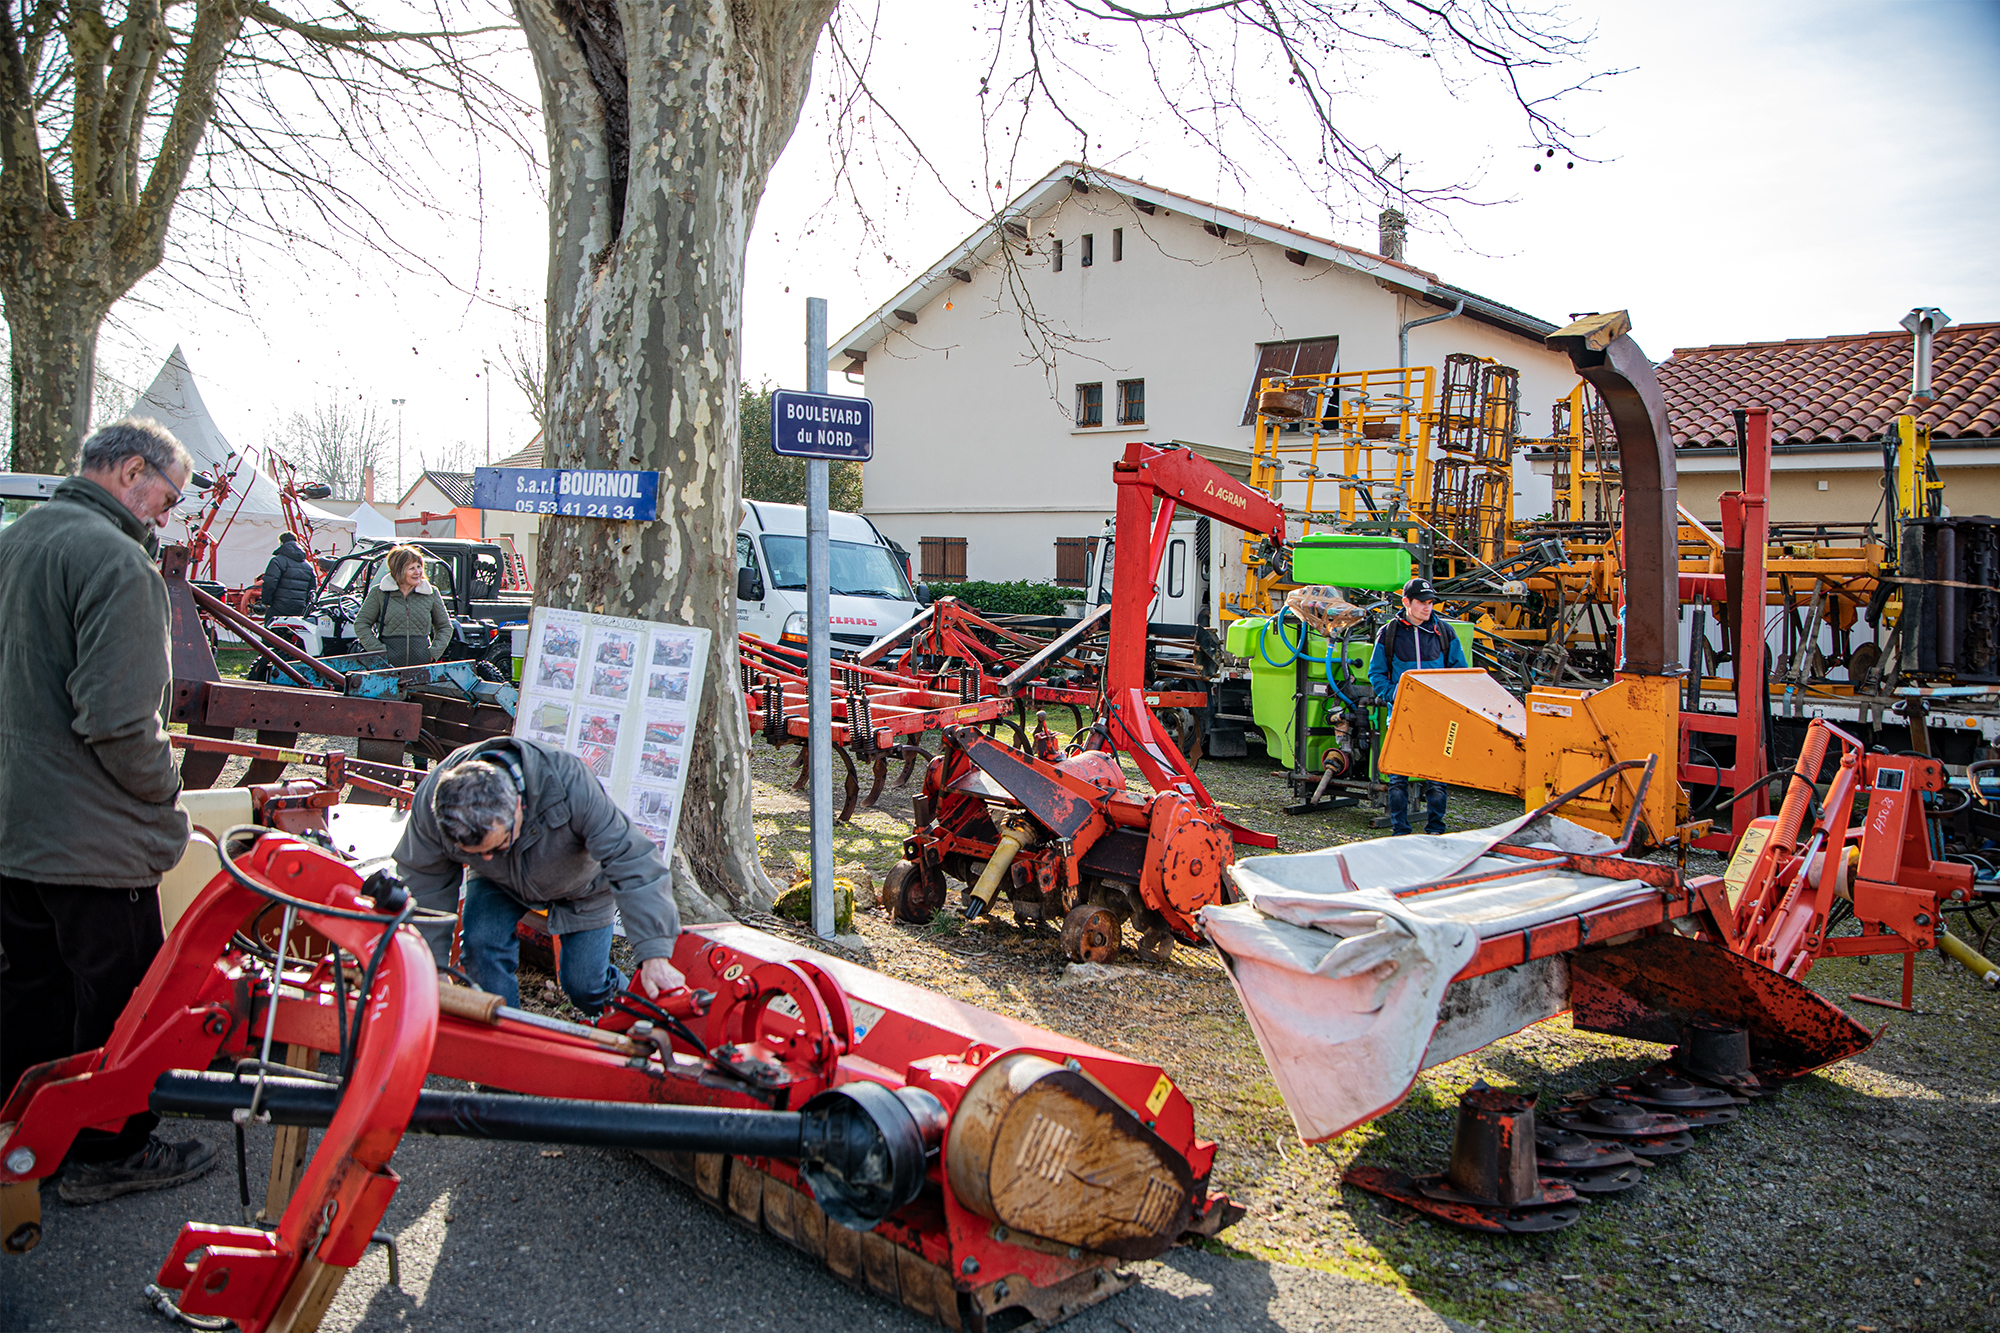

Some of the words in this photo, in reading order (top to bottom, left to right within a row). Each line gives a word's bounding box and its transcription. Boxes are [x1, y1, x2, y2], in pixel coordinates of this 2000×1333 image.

[787, 403, 862, 426] BOULEVARD
[797, 428, 812, 444] du
[818, 429, 853, 447] NORD
[559, 472, 642, 499] BOURNOL
[1215, 487, 1247, 510] AGRAM
[515, 500, 534, 513] 05
[538, 501, 558, 514] 53
[562, 503, 581, 515] 41
[586, 504, 608, 518] 24
[612, 505, 635, 519] 34
[591, 615, 646, 630] OCCASIONS
[829, 616, 877, 627] CLAAS
